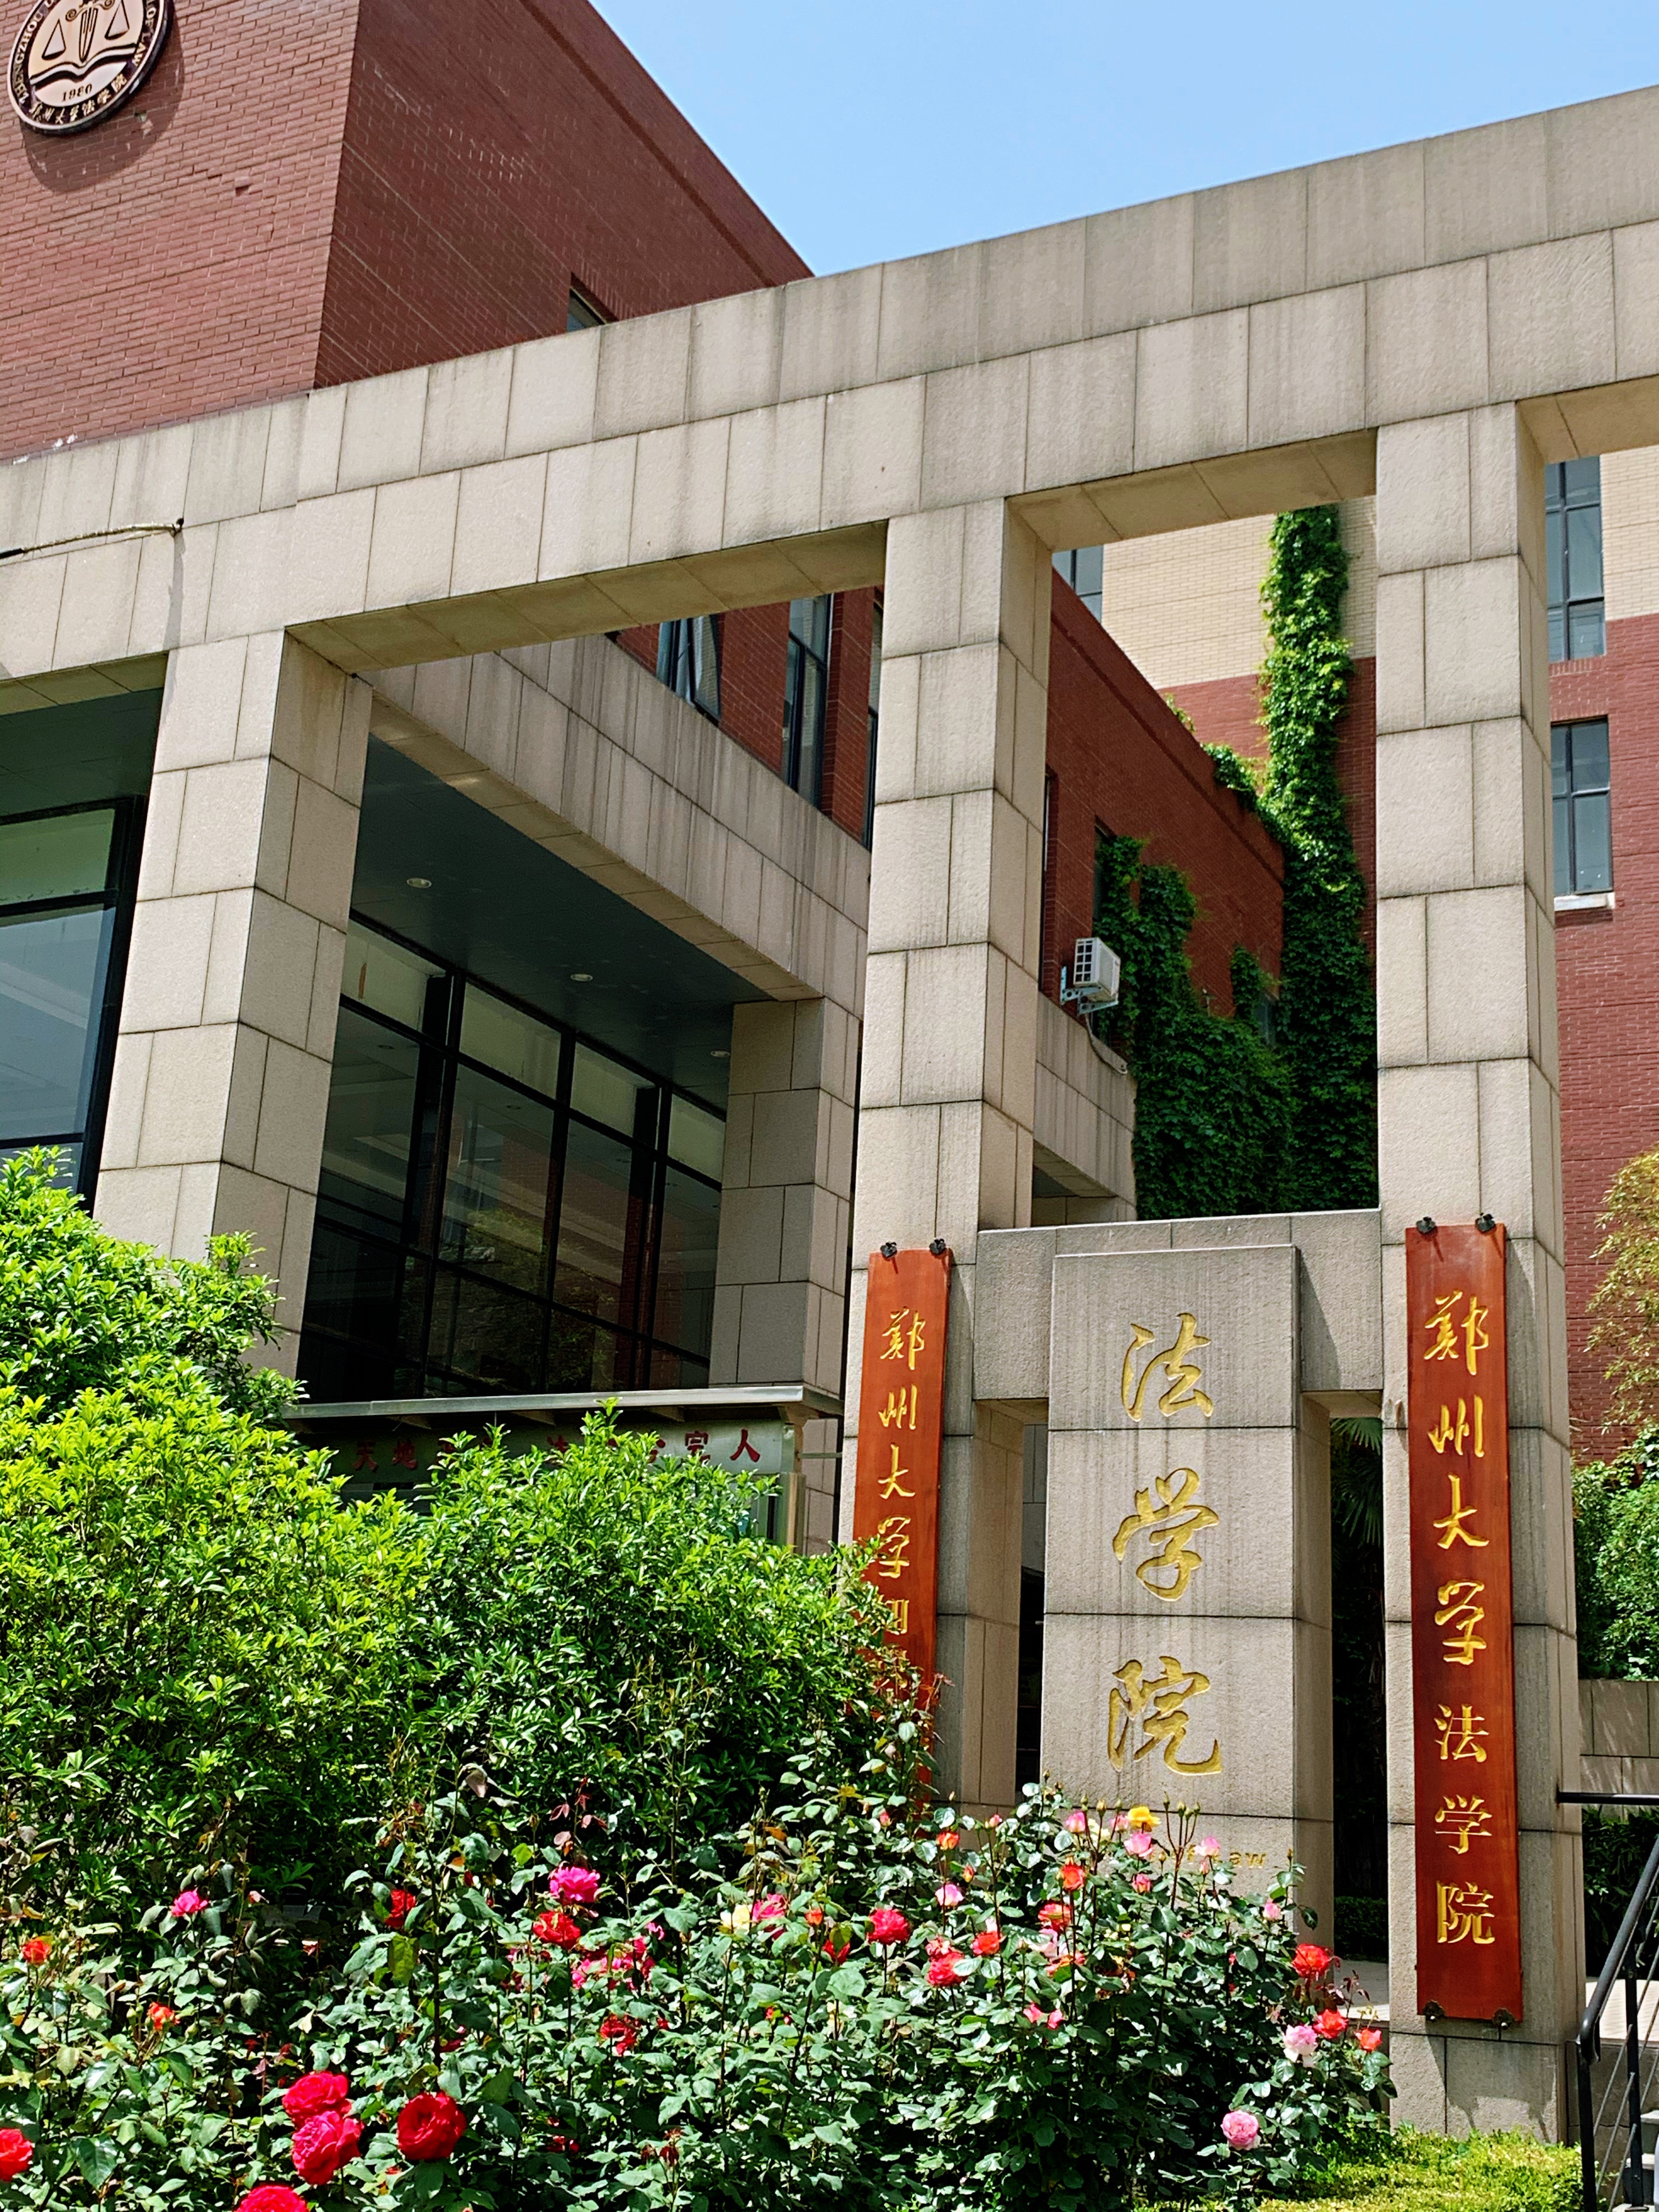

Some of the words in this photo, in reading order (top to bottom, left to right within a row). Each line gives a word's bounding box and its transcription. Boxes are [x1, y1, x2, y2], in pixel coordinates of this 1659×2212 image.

[61, 83, 93, 103] 1980
[1108, 1312, 1222, 1775] 法学院
